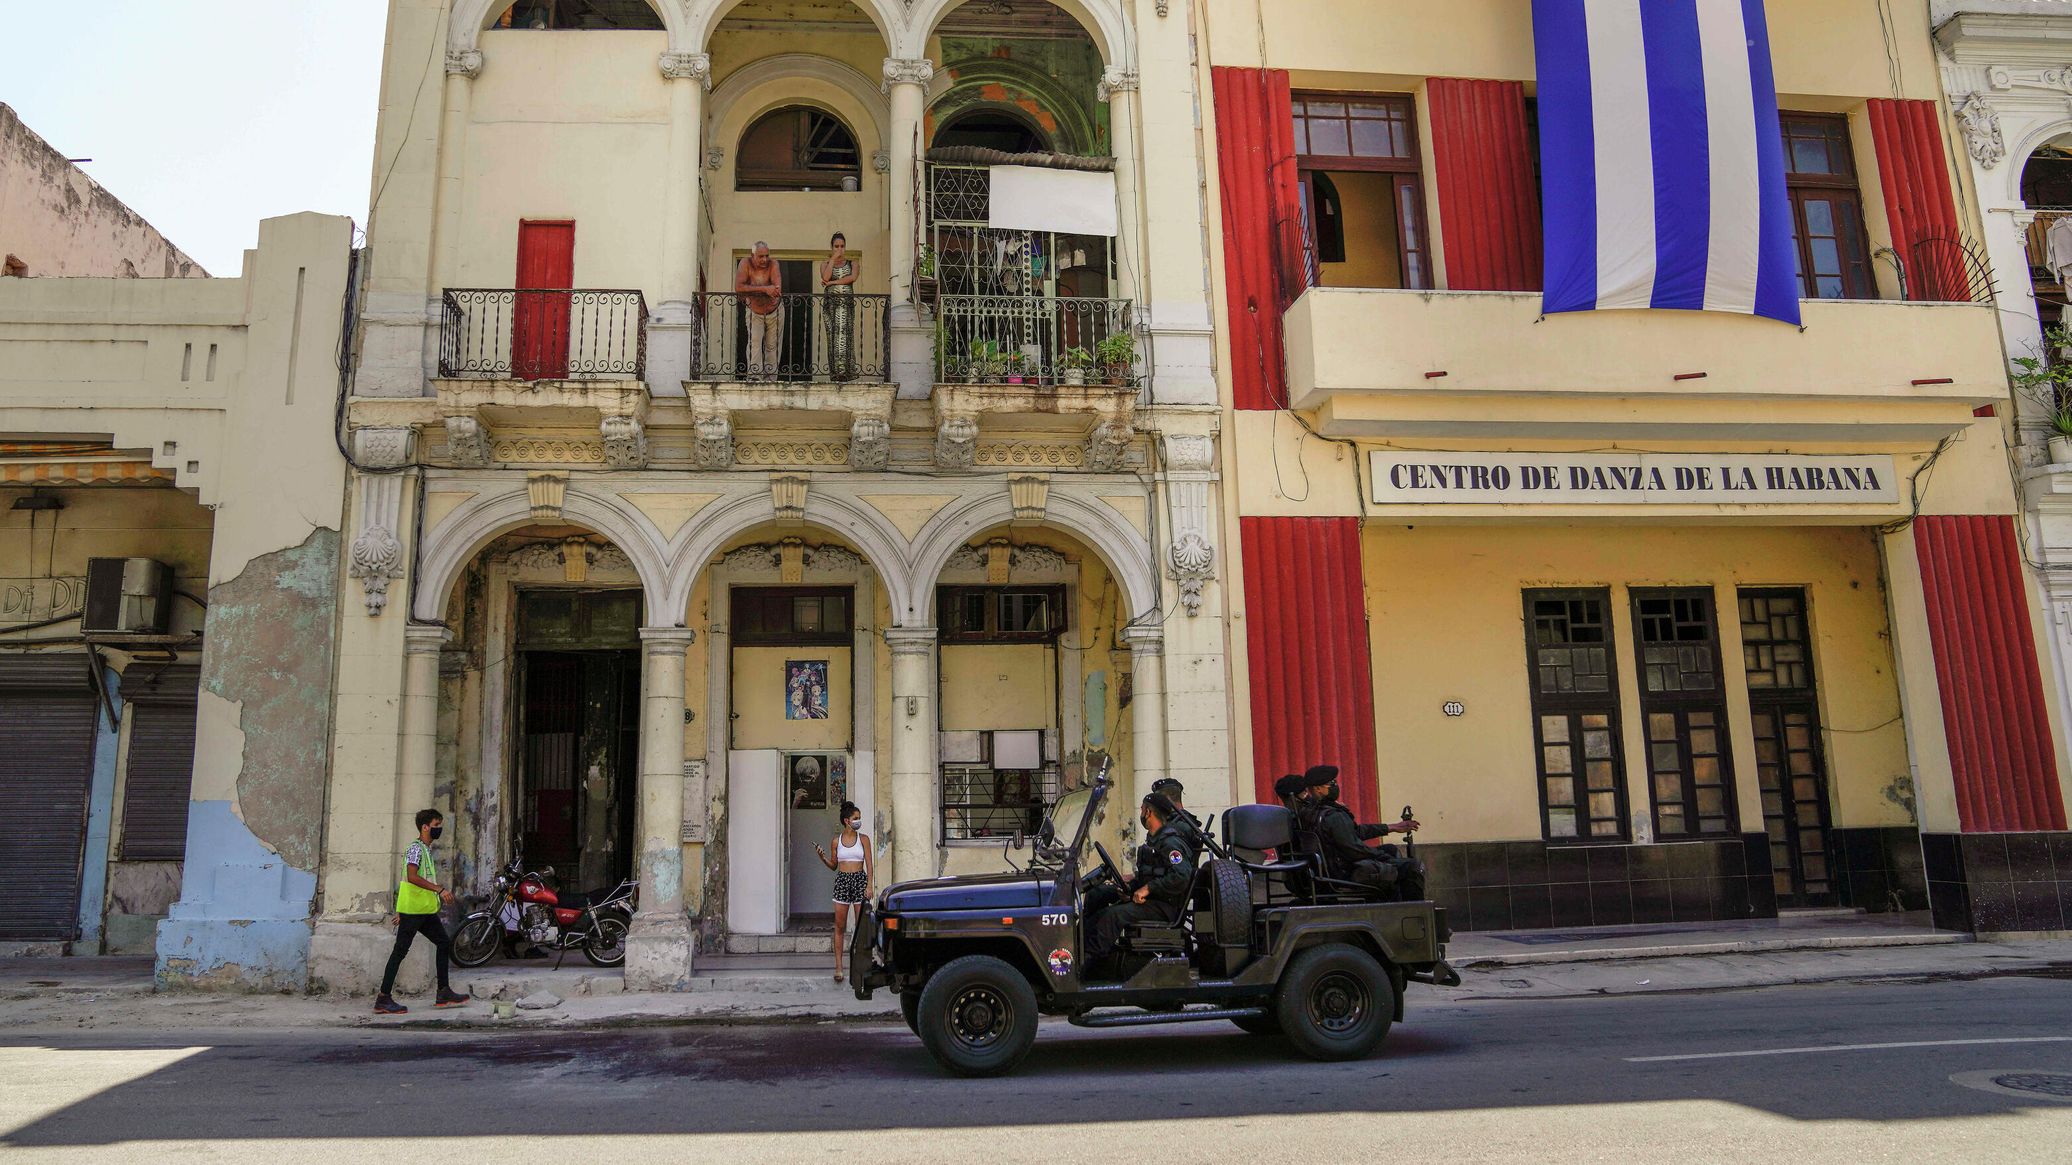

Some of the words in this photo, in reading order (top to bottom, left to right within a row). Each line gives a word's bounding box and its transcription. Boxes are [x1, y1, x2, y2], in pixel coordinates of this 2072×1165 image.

[1390, 463, 1511, 491] CENTRO
[1518, 465, 1561, 490] DE
[1567, 465, 1667, 491] DANZA
[1674, 466, 1714, 491] DE
[1719, 466, 1758, 491] LA
[1764, 466, 1882, 491] HABANA
[1447, 704, 1460, 714] 111
[1041, 913, 1068, 926] 570
